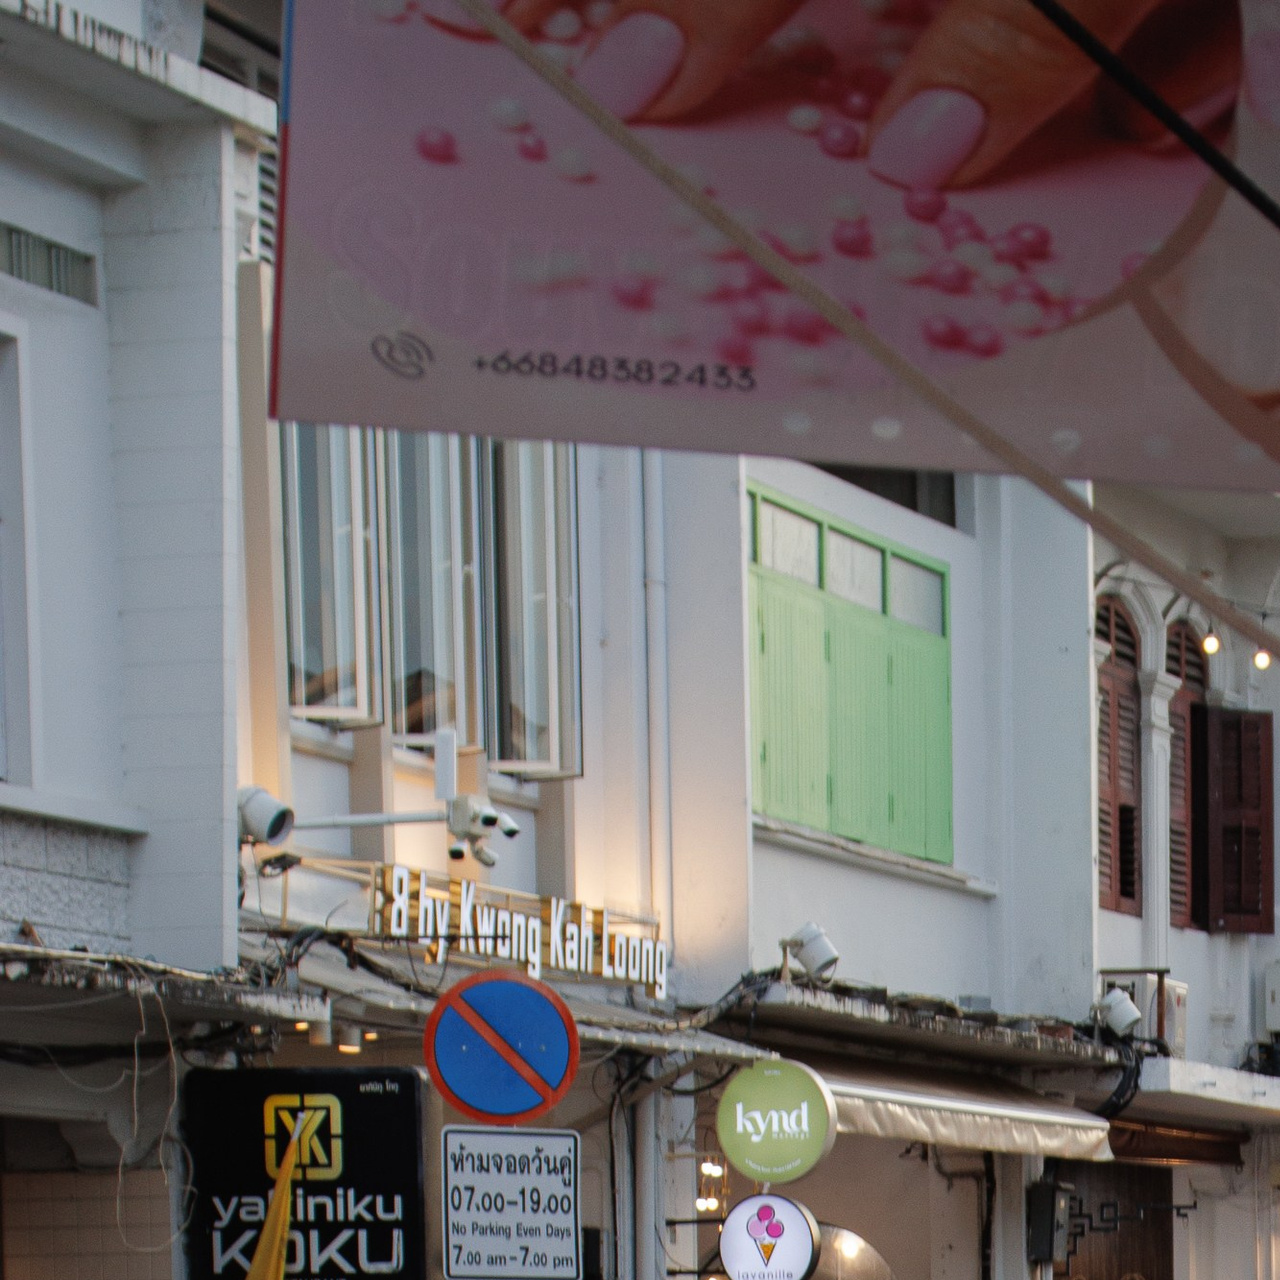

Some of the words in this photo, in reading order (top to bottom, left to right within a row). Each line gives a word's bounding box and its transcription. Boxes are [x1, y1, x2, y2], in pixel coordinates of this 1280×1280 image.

[390, 865, 409, 936] 8
[418, 871, 449, 964] by
[459, 879, 542, 980] Kwong
[551, 896, 593, 973] Kah
[602, 908, 667, 1000] Loong
[736, 1101, 809, 1143] kynd
[450, 1143, 572, 1188] ห้ามจอดวันคู่
[212, 1187, 404, 1229] yainiku
[451, 1221, 467, 1236] No
[471, 1221, 511, 1240] Parking
[516, 1222, 541, 1238] Even
[545, 1223, 571, 1241] Days
[553, 1256, 573, 1269] pm
[737, 1270, 794, 1280] lavanille
